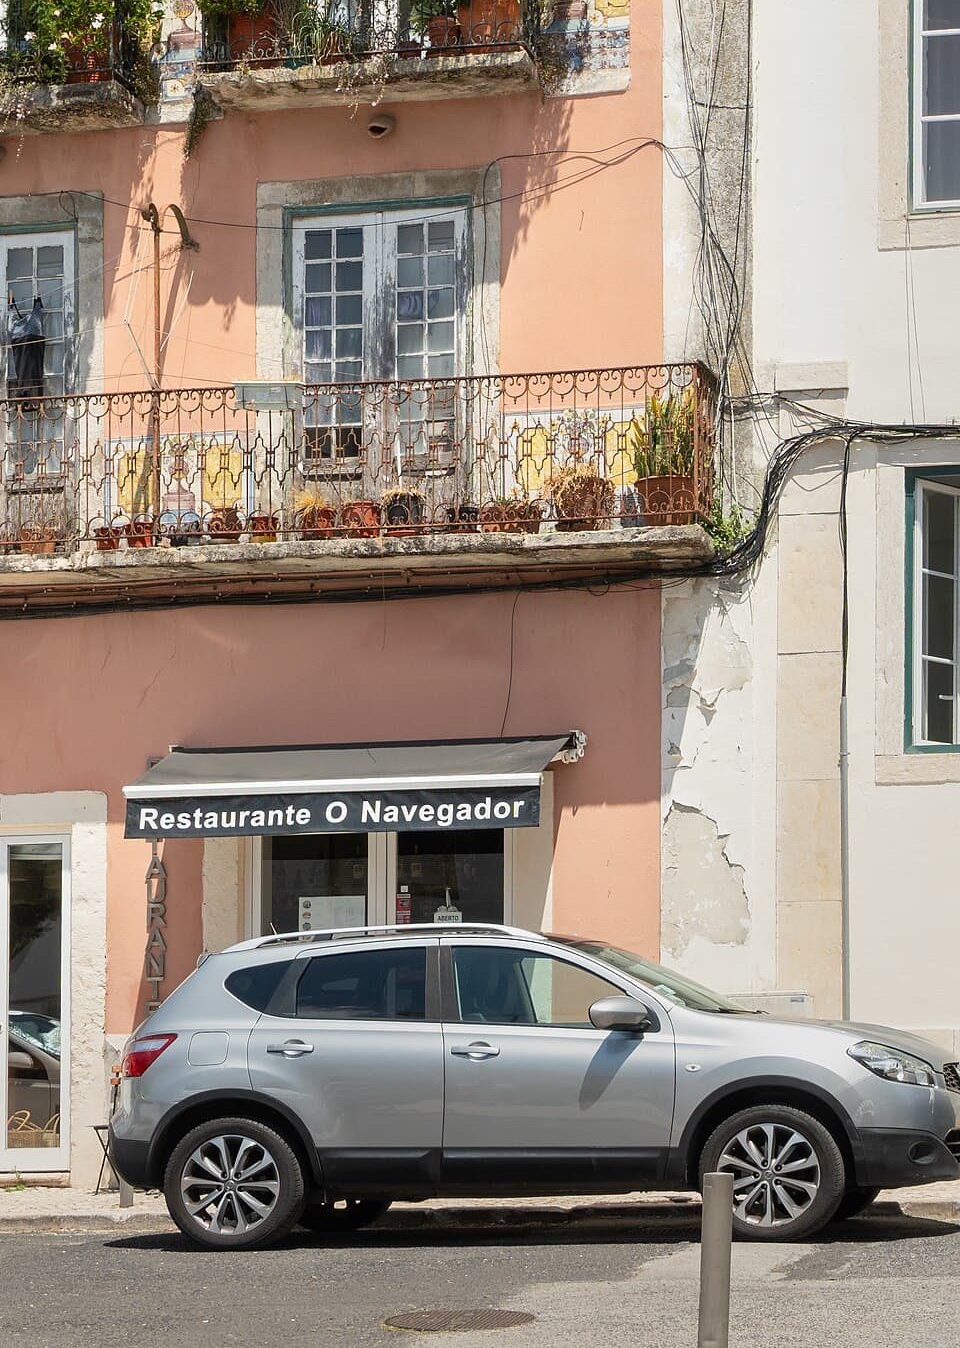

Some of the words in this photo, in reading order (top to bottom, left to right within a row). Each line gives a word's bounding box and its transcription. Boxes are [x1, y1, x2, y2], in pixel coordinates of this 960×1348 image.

[139, 804, 311, 830] Restaurante
[325, 801, 348, 824] O
[361, 797, 525, 827] Navegador
